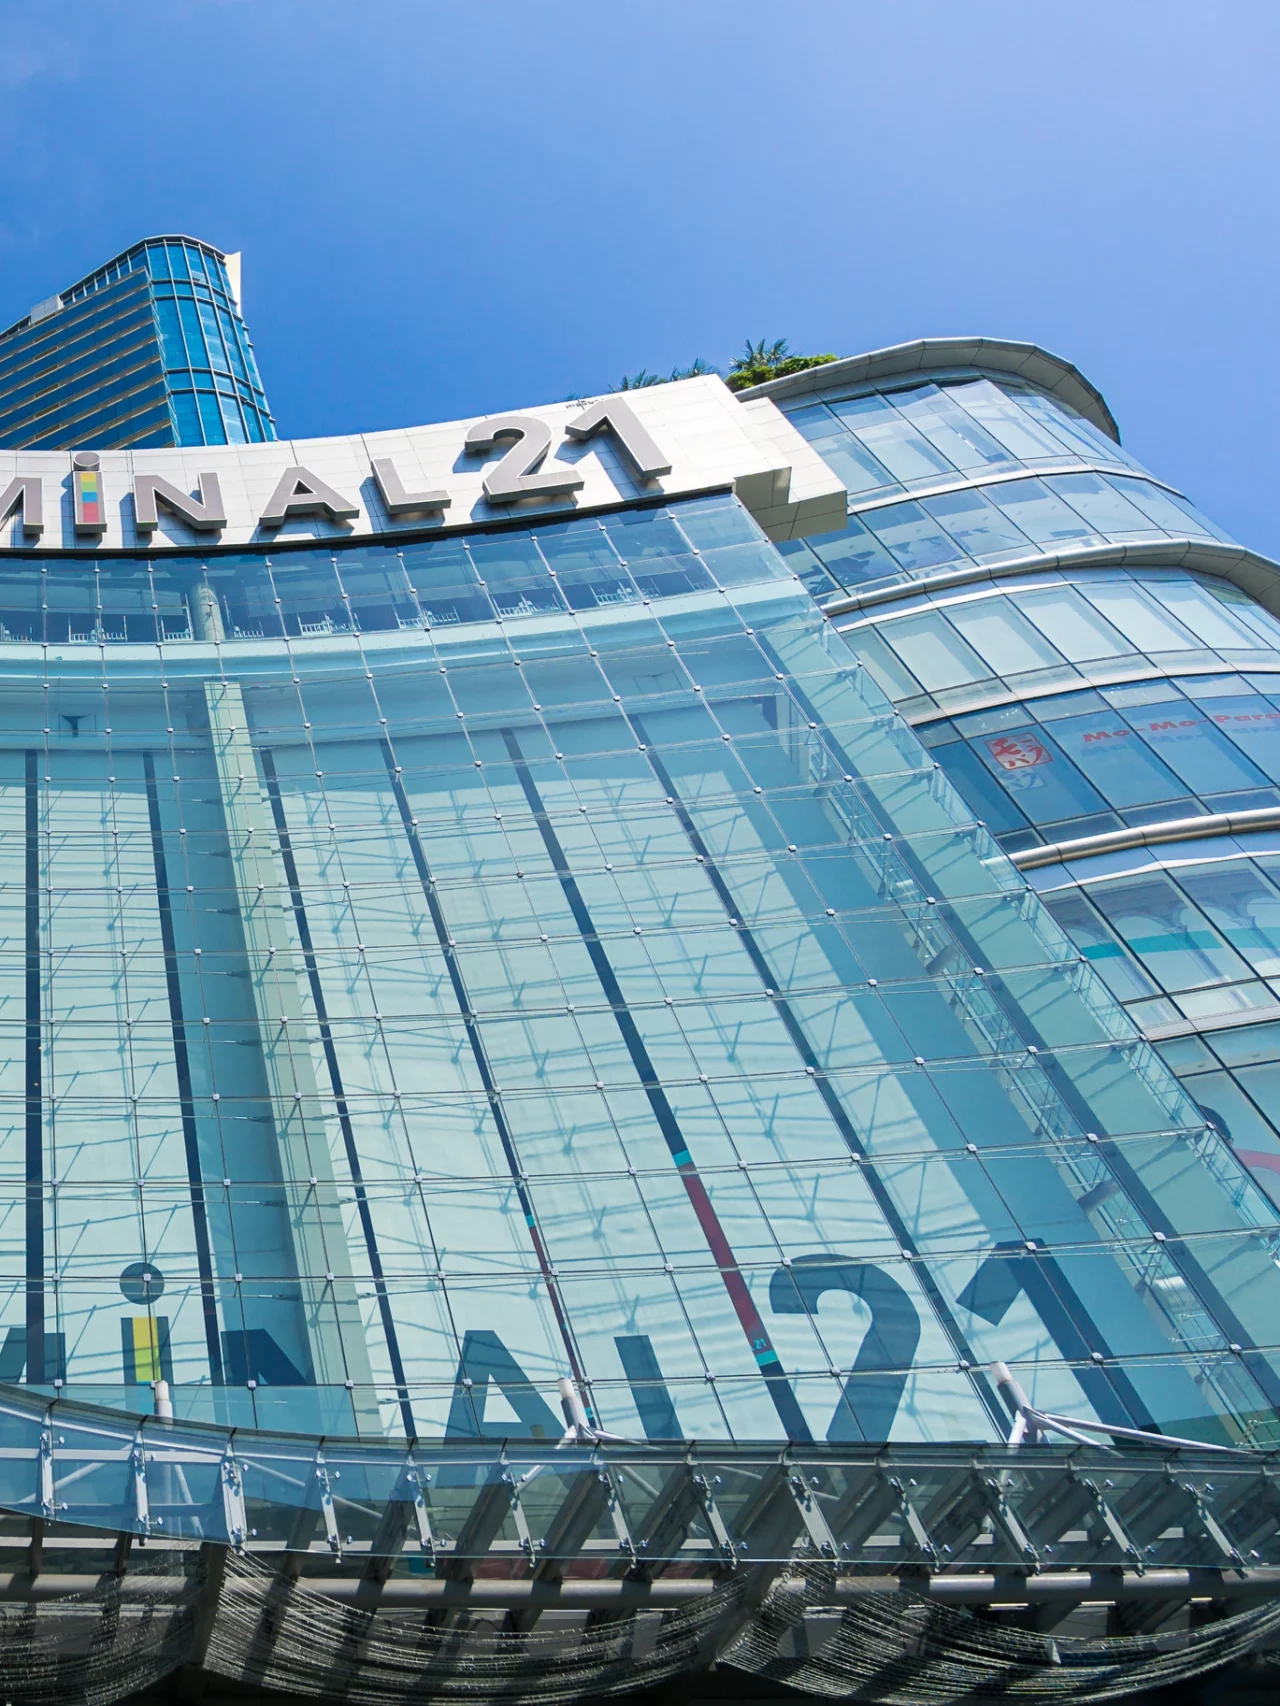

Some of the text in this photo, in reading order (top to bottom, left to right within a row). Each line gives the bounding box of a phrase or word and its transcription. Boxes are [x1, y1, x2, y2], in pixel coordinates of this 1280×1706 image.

[465, 396, 672, 504] 21
[753, 1338, 767, 1351] 21
[768, 1238, 1163, 1445] 21
